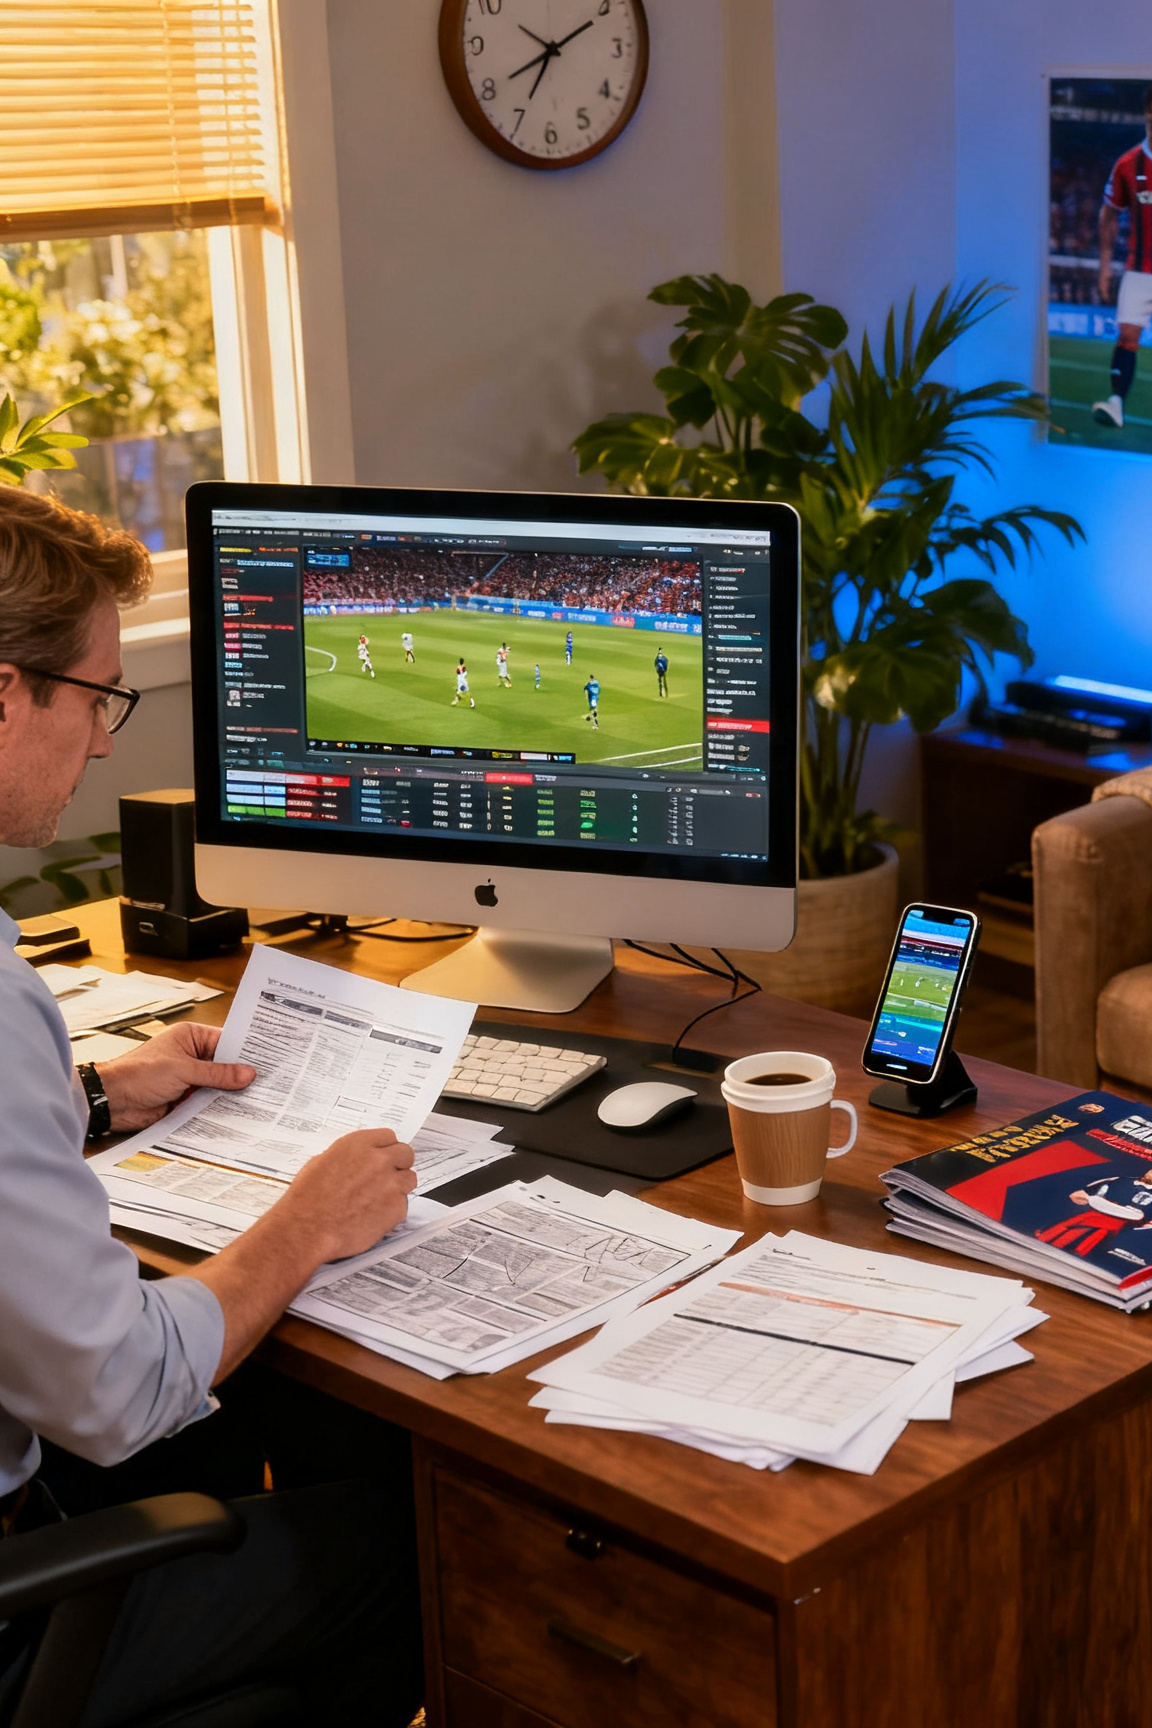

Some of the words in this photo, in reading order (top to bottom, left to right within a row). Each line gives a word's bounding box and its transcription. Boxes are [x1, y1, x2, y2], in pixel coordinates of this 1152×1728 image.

[481, 77, 496, 101] 8
[598, 79, 610, 99] 4
[513, 108, 526, 137] 7
[576, 107, 590, 130] 5
[544, 121, 558, 145] 6
